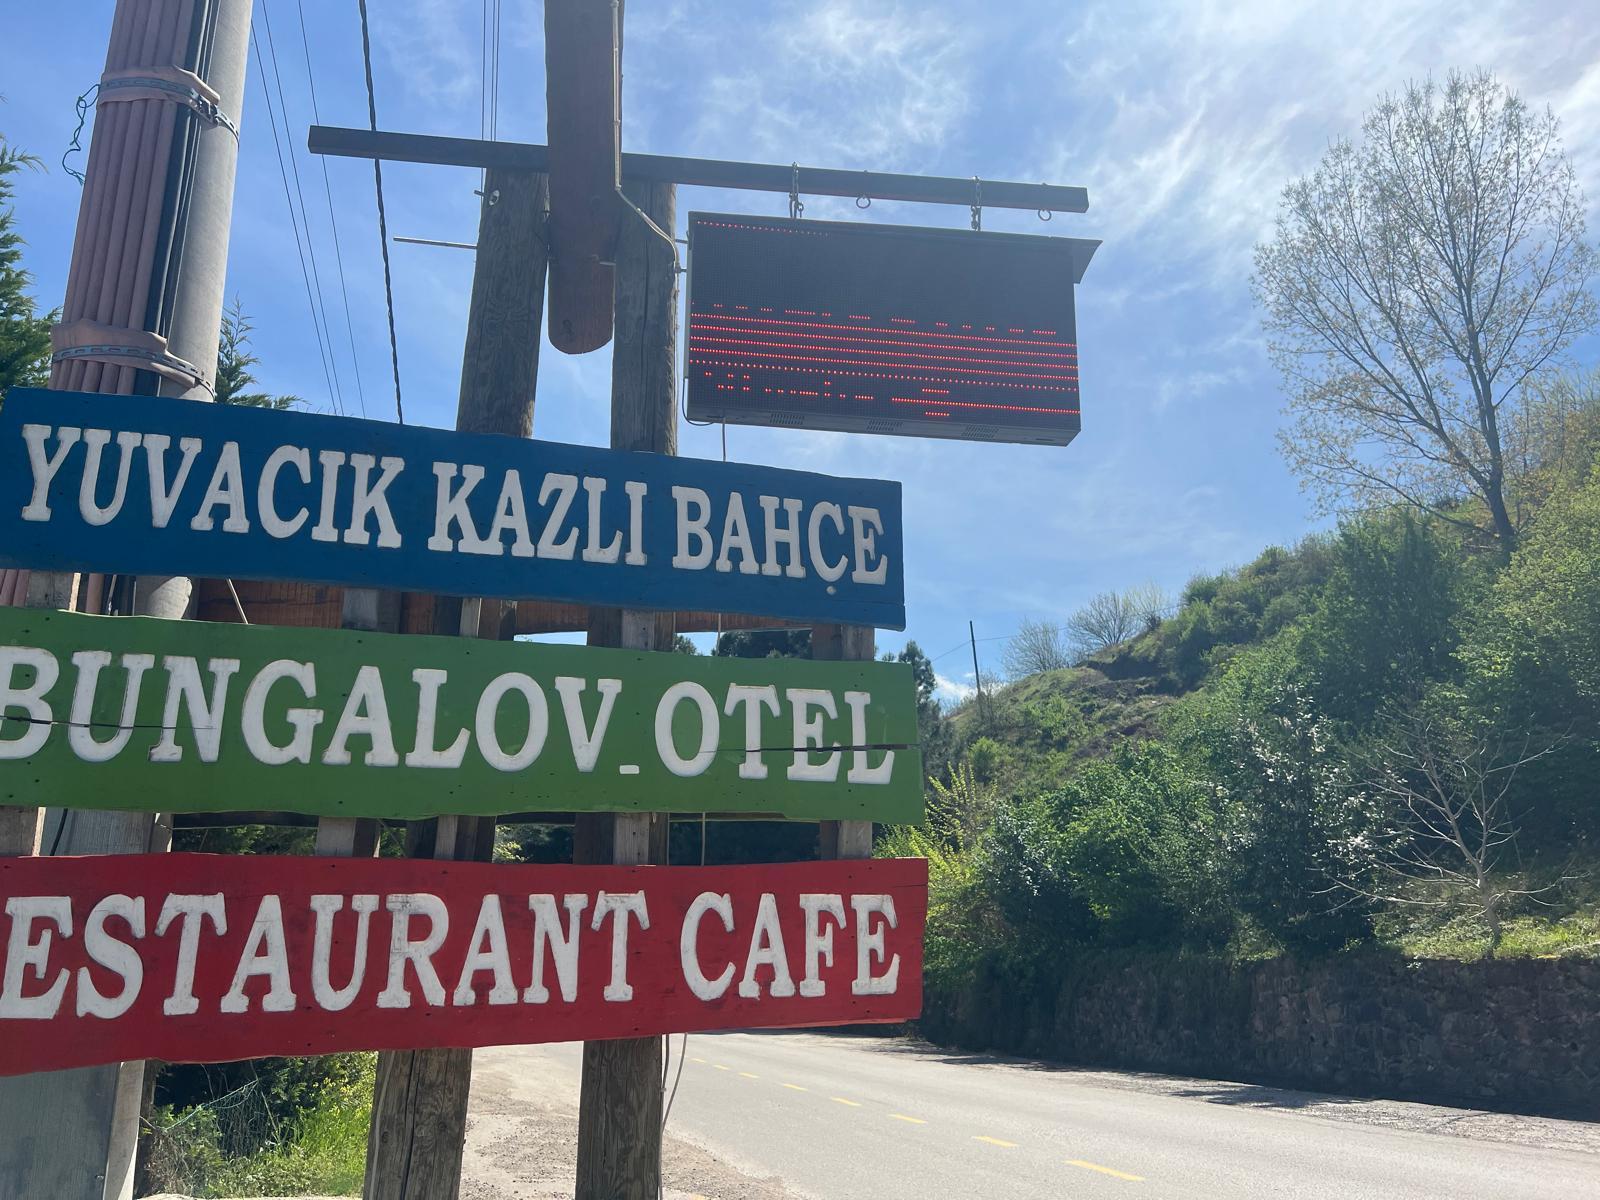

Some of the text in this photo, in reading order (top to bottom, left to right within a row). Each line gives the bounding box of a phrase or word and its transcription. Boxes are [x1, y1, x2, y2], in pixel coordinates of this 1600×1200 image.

[21, 423, 889, 596] YUVACIK KAZLI BAHÇE
[654, 680, 896, 785] OTEL
[0, 889, 901, 1020] ESTAURANT CAFE
